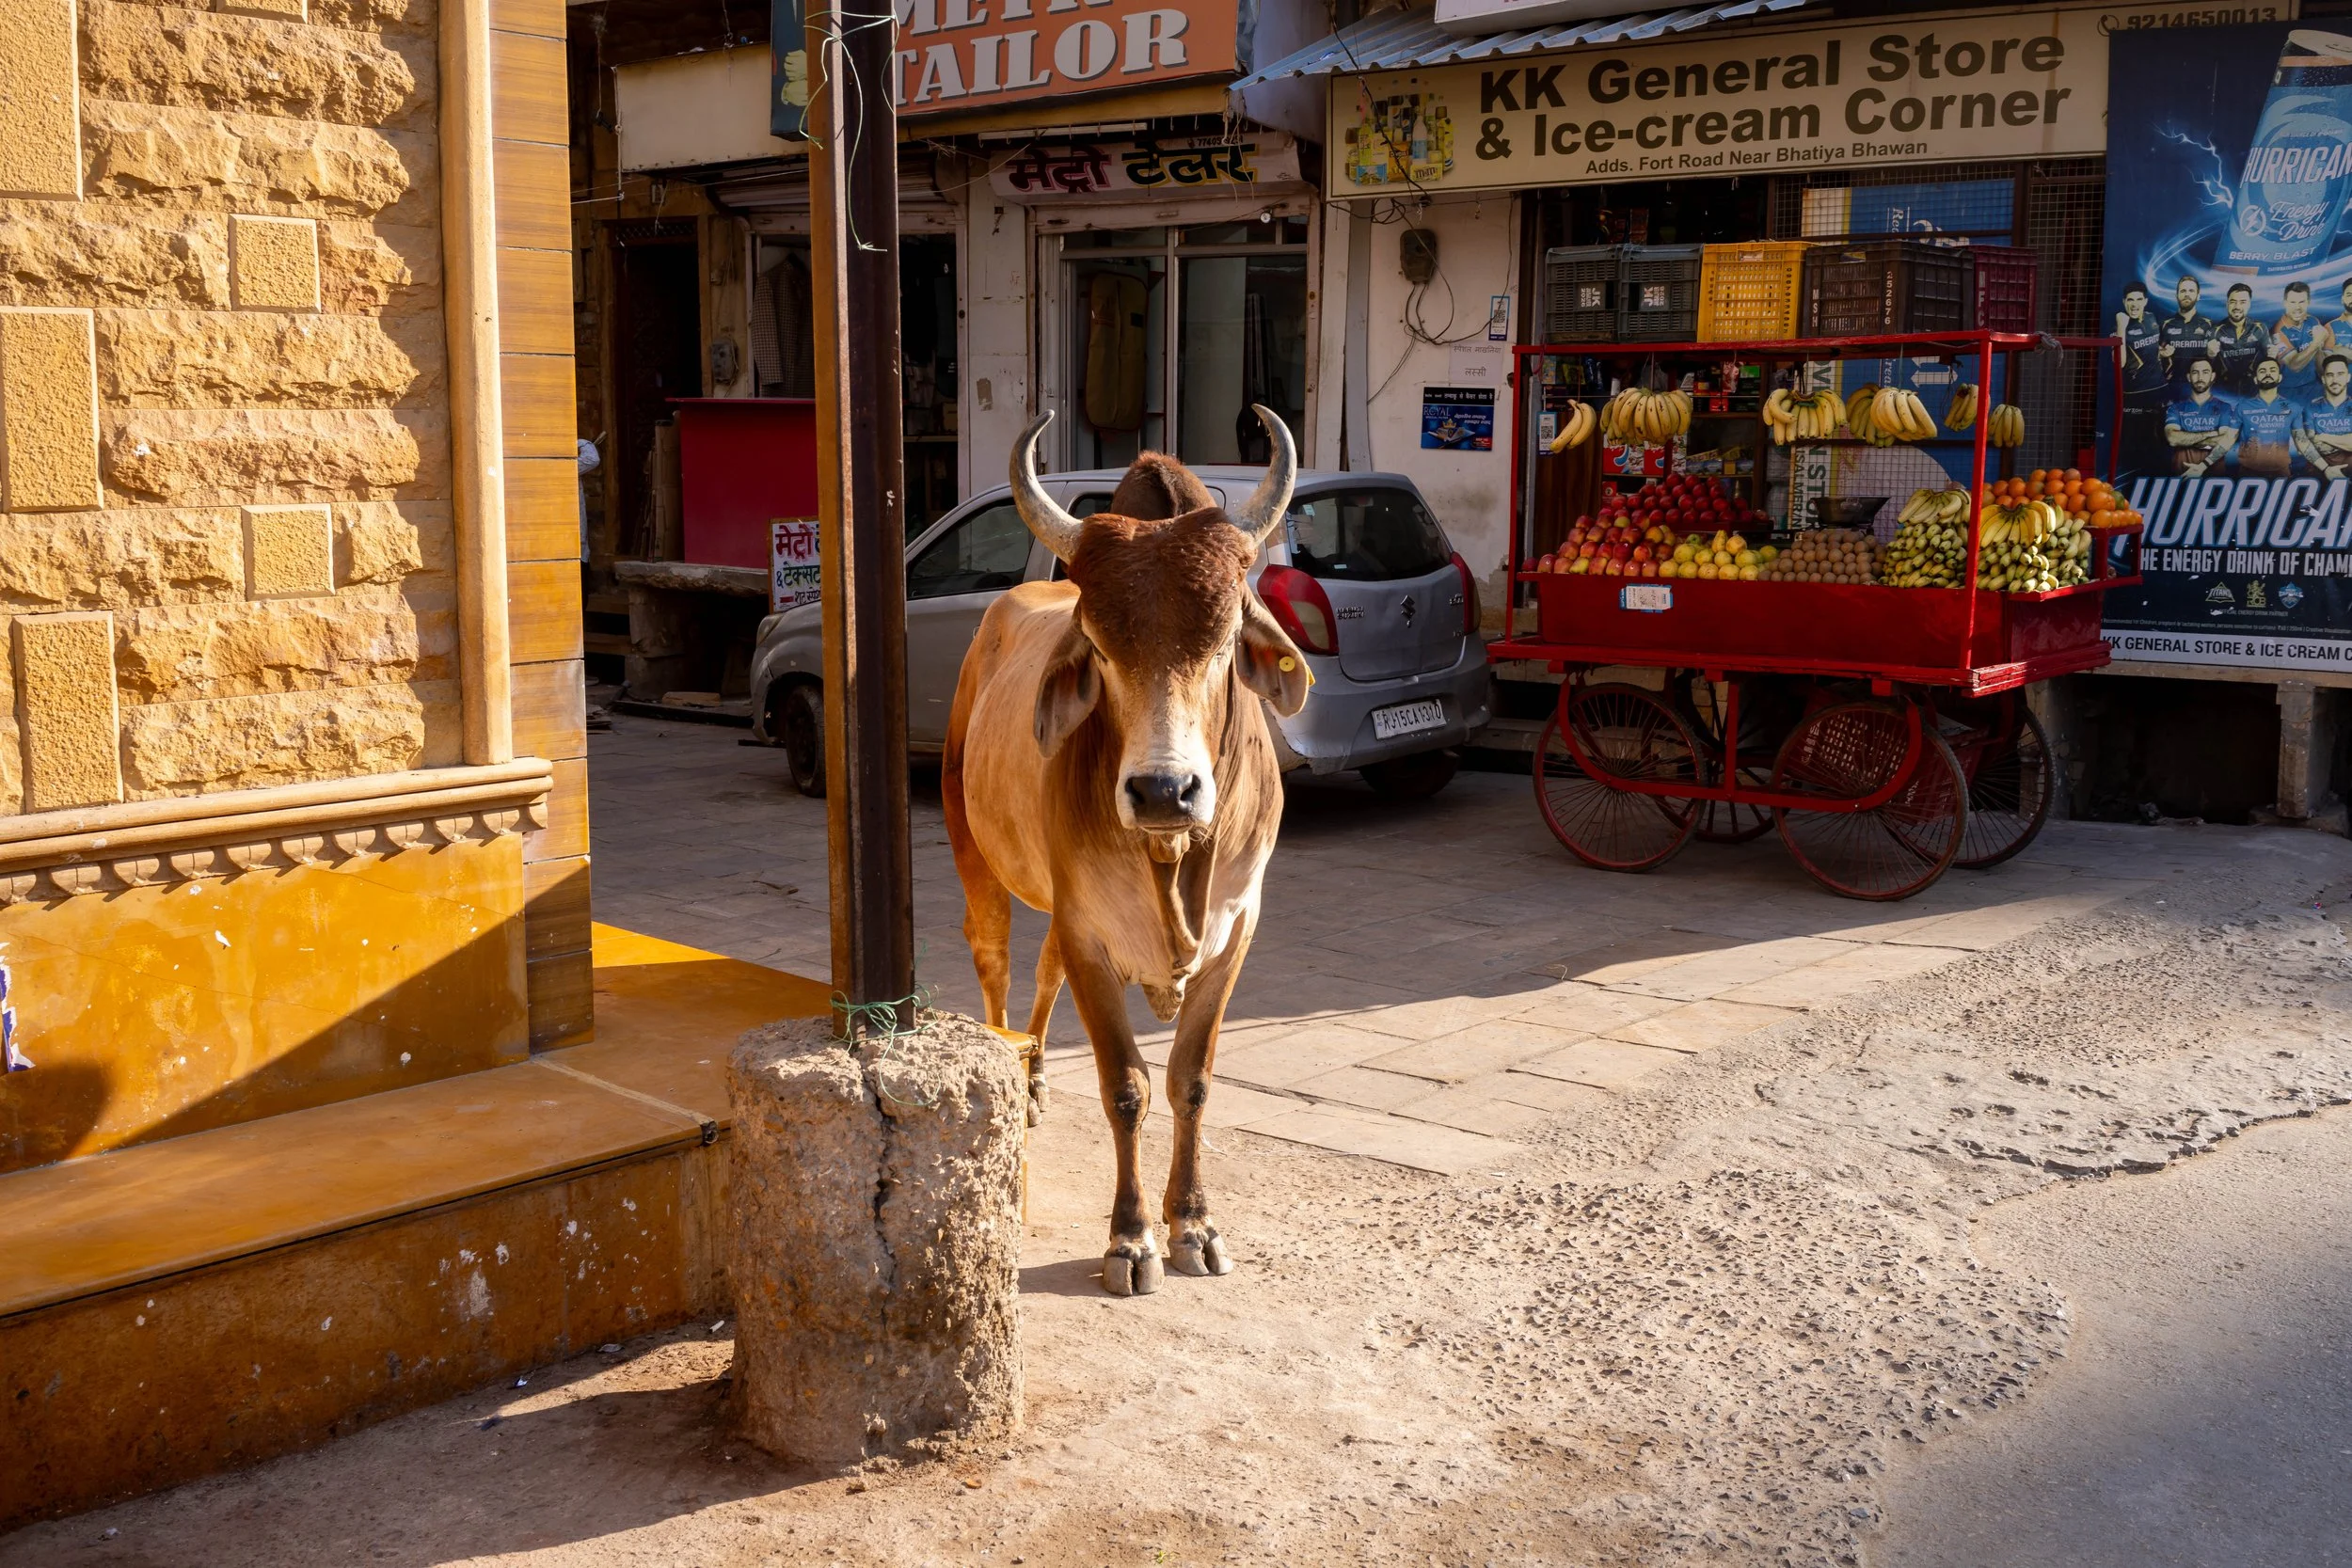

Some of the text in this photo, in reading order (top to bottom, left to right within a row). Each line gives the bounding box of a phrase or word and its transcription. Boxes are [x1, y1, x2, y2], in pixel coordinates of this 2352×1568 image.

[2127, 8, 2276, 30] 9214650013
[894, 8, 1188, 105] TAILOR
[1480, 32, 2064, 114] KK General Store
[1475, 87, 2072, 161] & Ice-cream Corner
[1005, 140, 1259, 193] मेट्रो टेलर
[1585, 141, 1928, 174] Adds. Fort Road Near Bhatiya Bhawan
[2270, 201, 2329, 225] Energy
[2279, 217, 2327, 241] Drink
[2229, 246, 2317, 261] BERRY BLAST
[2223, 347, 2256, 357] DREAM11
[1465, 366, 1486, 377] लस्सी
[1423, 406, 1451, 416] ROYAL
[2184, 417, 2215, 426] QATAR
[2250, 415, 2285, 423] QATAR
[2317, 419, 2350, 428] QATAR
[775, 524, 813, 559] मेट्रो
[2140, 548, 2158, 570] HE
[2163, 549, 2222, 573] ENERGY
[2227, 550, 2275, 575] DRINK
[2280, 552, 2300, 575] OF
[2246, 596, 2266, 606] RCB
[2125, 637, 2190, 653] GENERAL
[2194, 641, 2242, 655] STORE
[2246, 642, 2255, 656] &
[2261, 643, 2284, 657] ICE
[2288, 644, 2340, 660] CREAM
